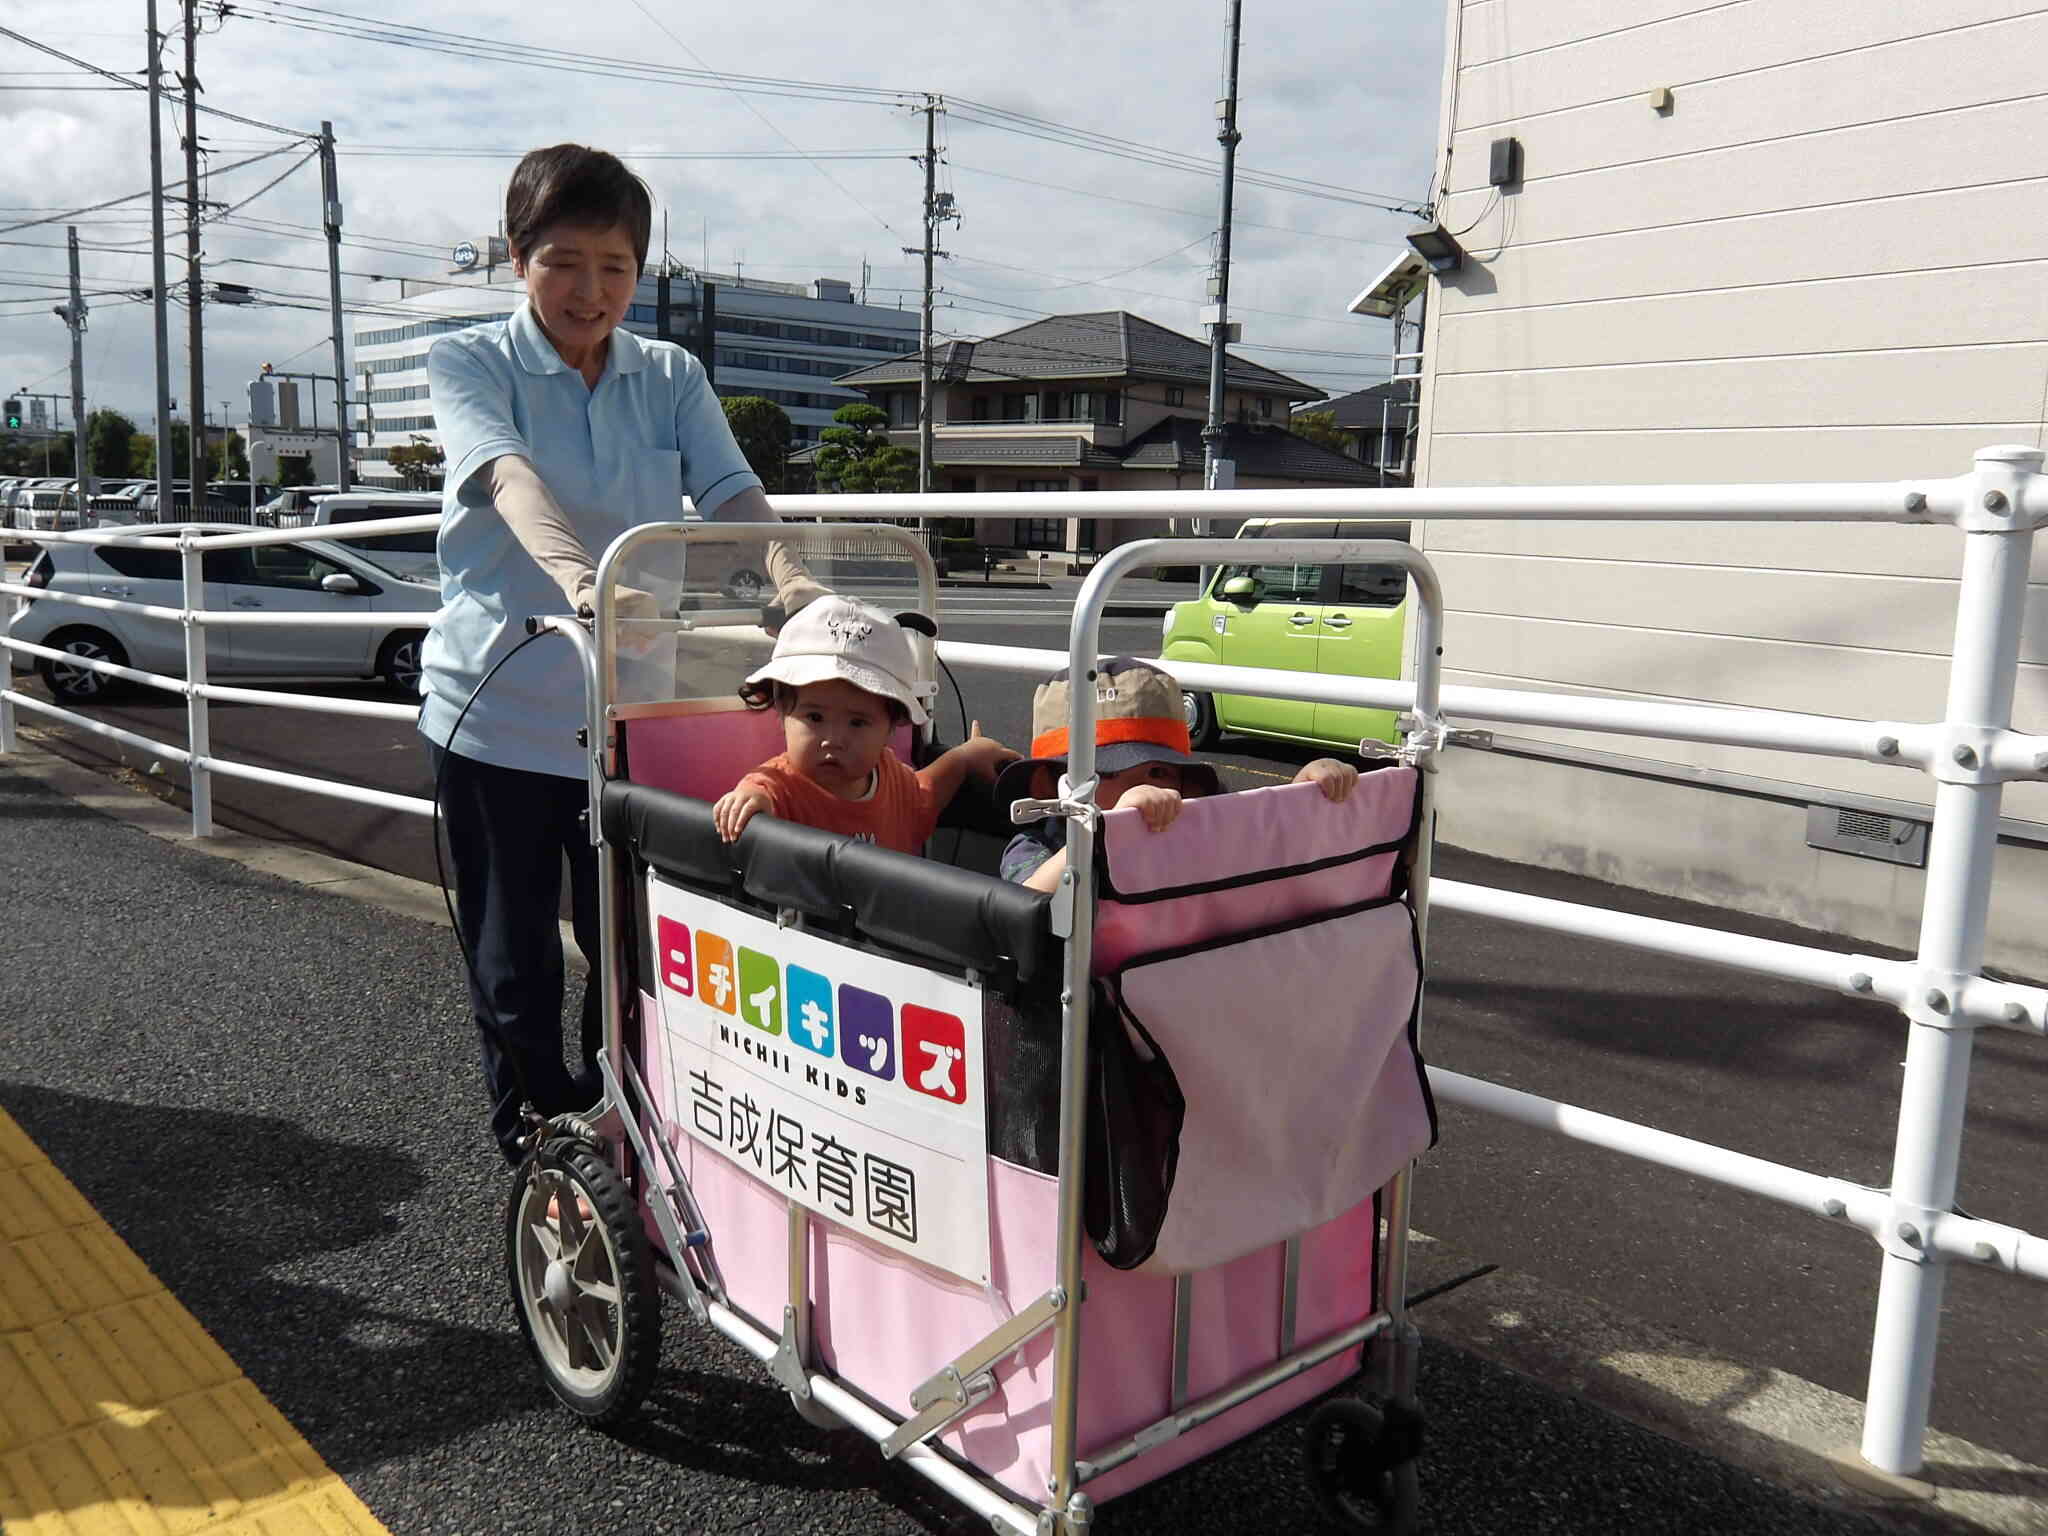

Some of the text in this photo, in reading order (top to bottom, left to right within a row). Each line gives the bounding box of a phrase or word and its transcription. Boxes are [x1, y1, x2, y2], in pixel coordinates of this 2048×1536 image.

[665, 942, 964, 1099] ニチイキッズ
[720, 1025, 867, 1105] NICHII KIDS
[689, 1070, 918, 1243] 吉成保育園
